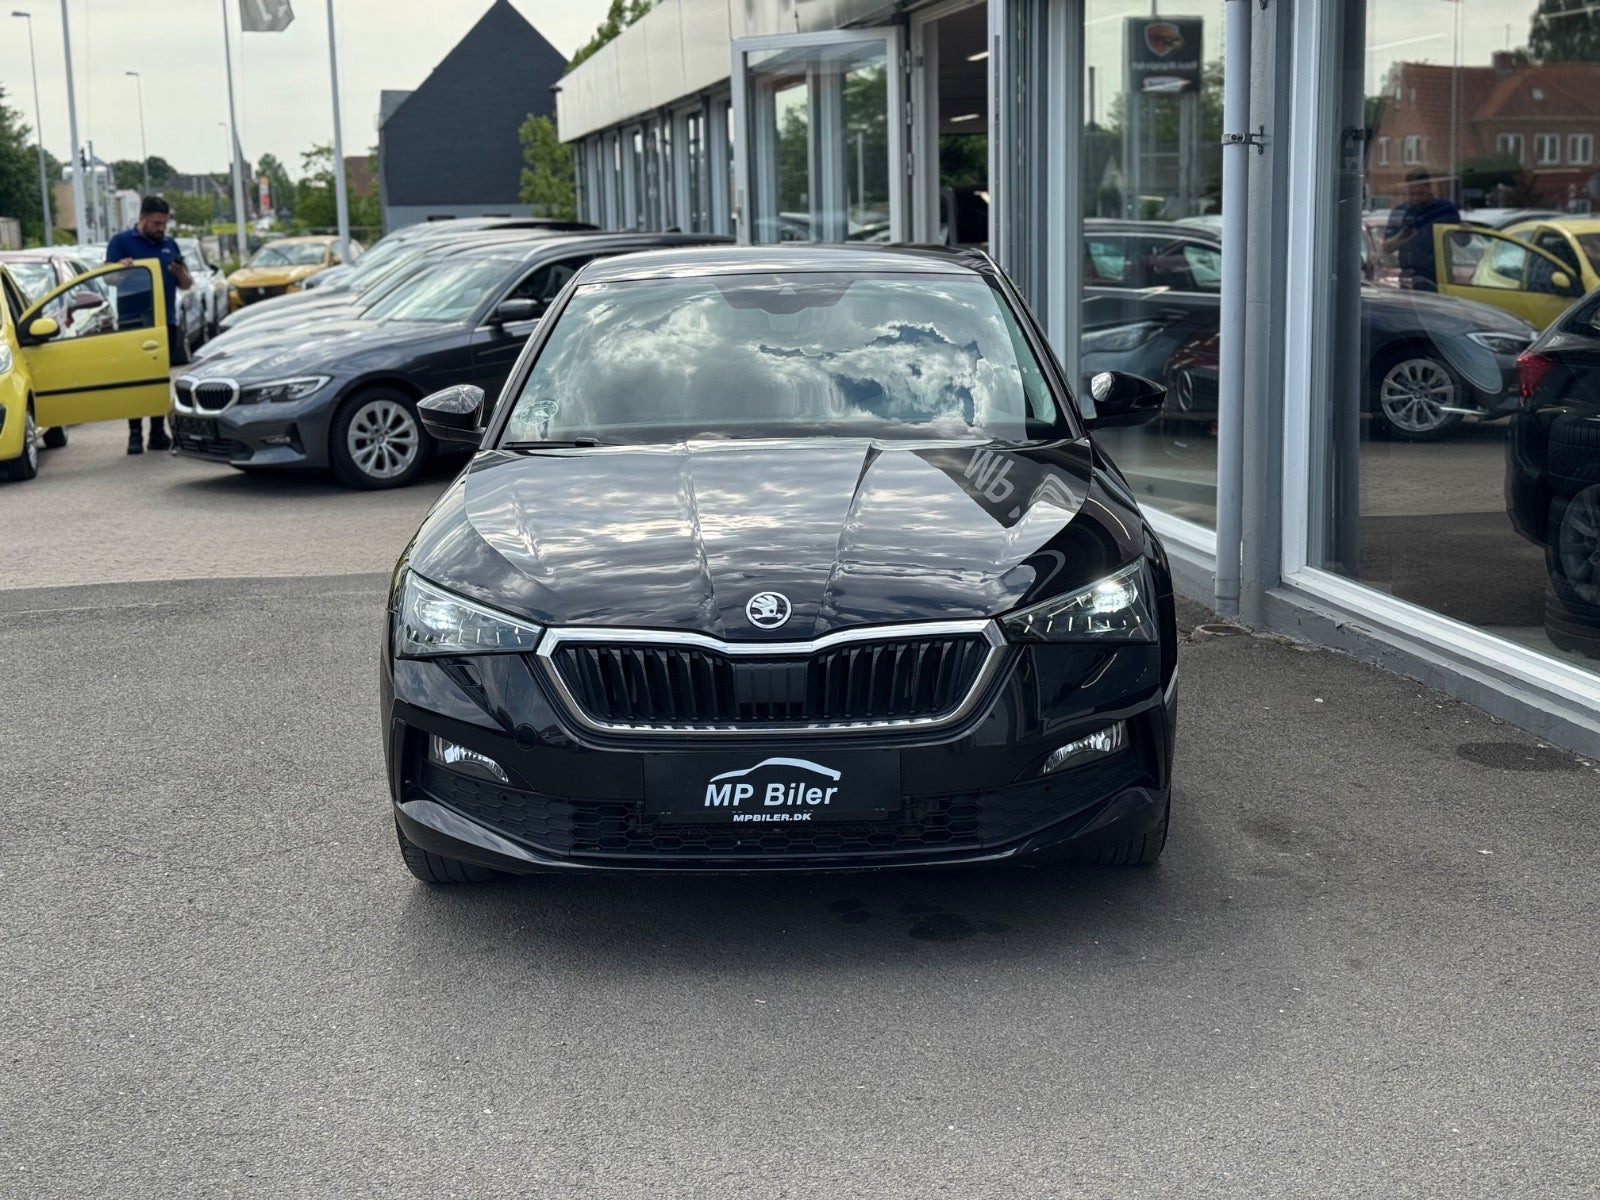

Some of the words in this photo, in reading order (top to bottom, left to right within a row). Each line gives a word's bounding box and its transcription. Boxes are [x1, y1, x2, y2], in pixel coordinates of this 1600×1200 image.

[704, 783, 754, 806] MP
[763, 782, 838, 806] Biler
[732, 813, 812, 822] MPBILER.DK
